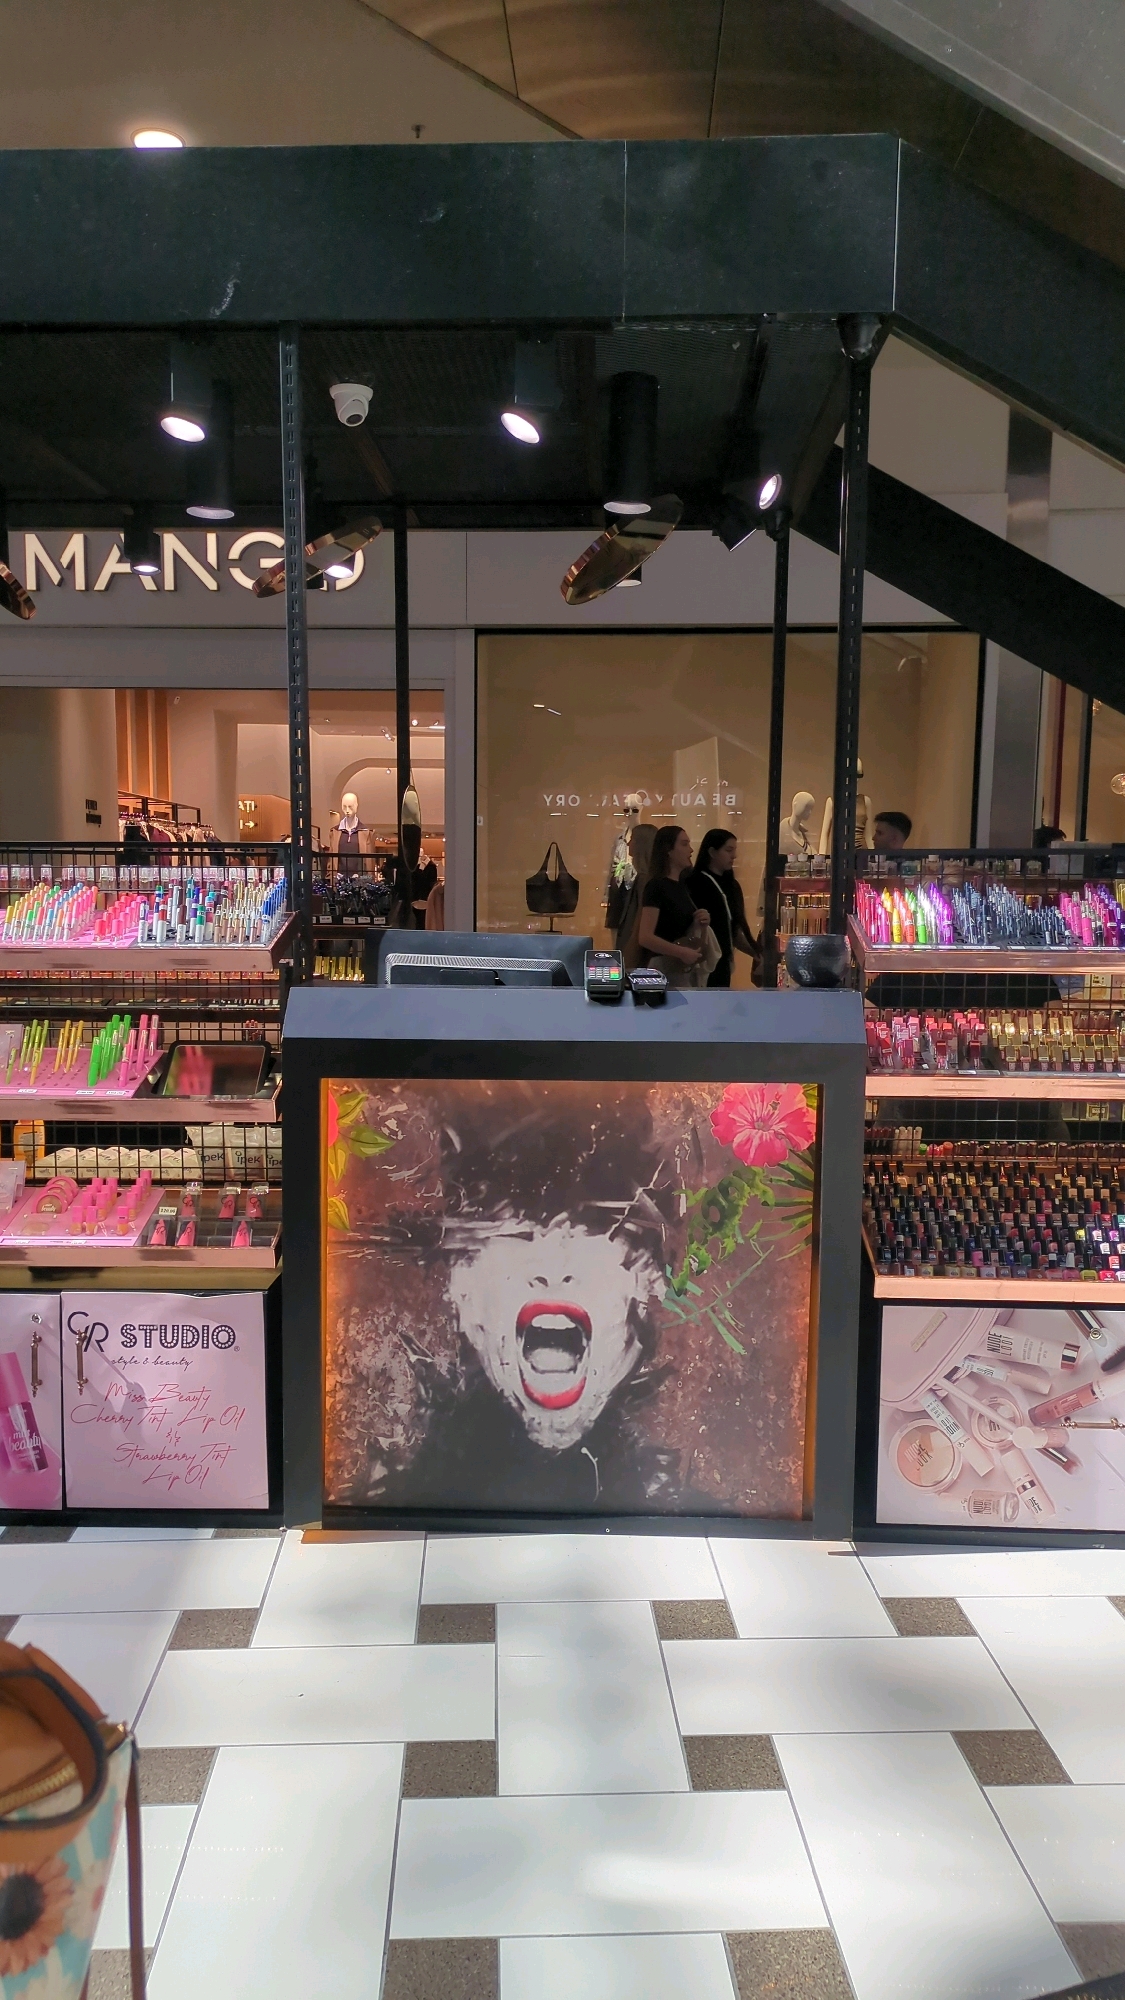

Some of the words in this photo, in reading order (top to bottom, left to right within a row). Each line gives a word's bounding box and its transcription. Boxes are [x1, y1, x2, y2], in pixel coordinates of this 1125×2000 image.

[120, 1323, 236, 1350] STUDIO
[111, 1355, 141, 1370] style
[152, 1355, 194, 1371] beauty
[105, 1381, 145, 1402] Miss
[148, 1383, 212, 1412] Beauty
[70, 1403, 134, 1433] Cherry
[137, 1405, 173, 1432] Tint
[177, 1404, 216, 1434] Lip
[220, 1405, 246, 1431] Oil
[114, 1442, 197, 1471] Strawberry
[200, 1442, 238, 1469] Tint
[141, 1464, 180, 1491] Lip
[185, 1464, 210, 1490] Oil
